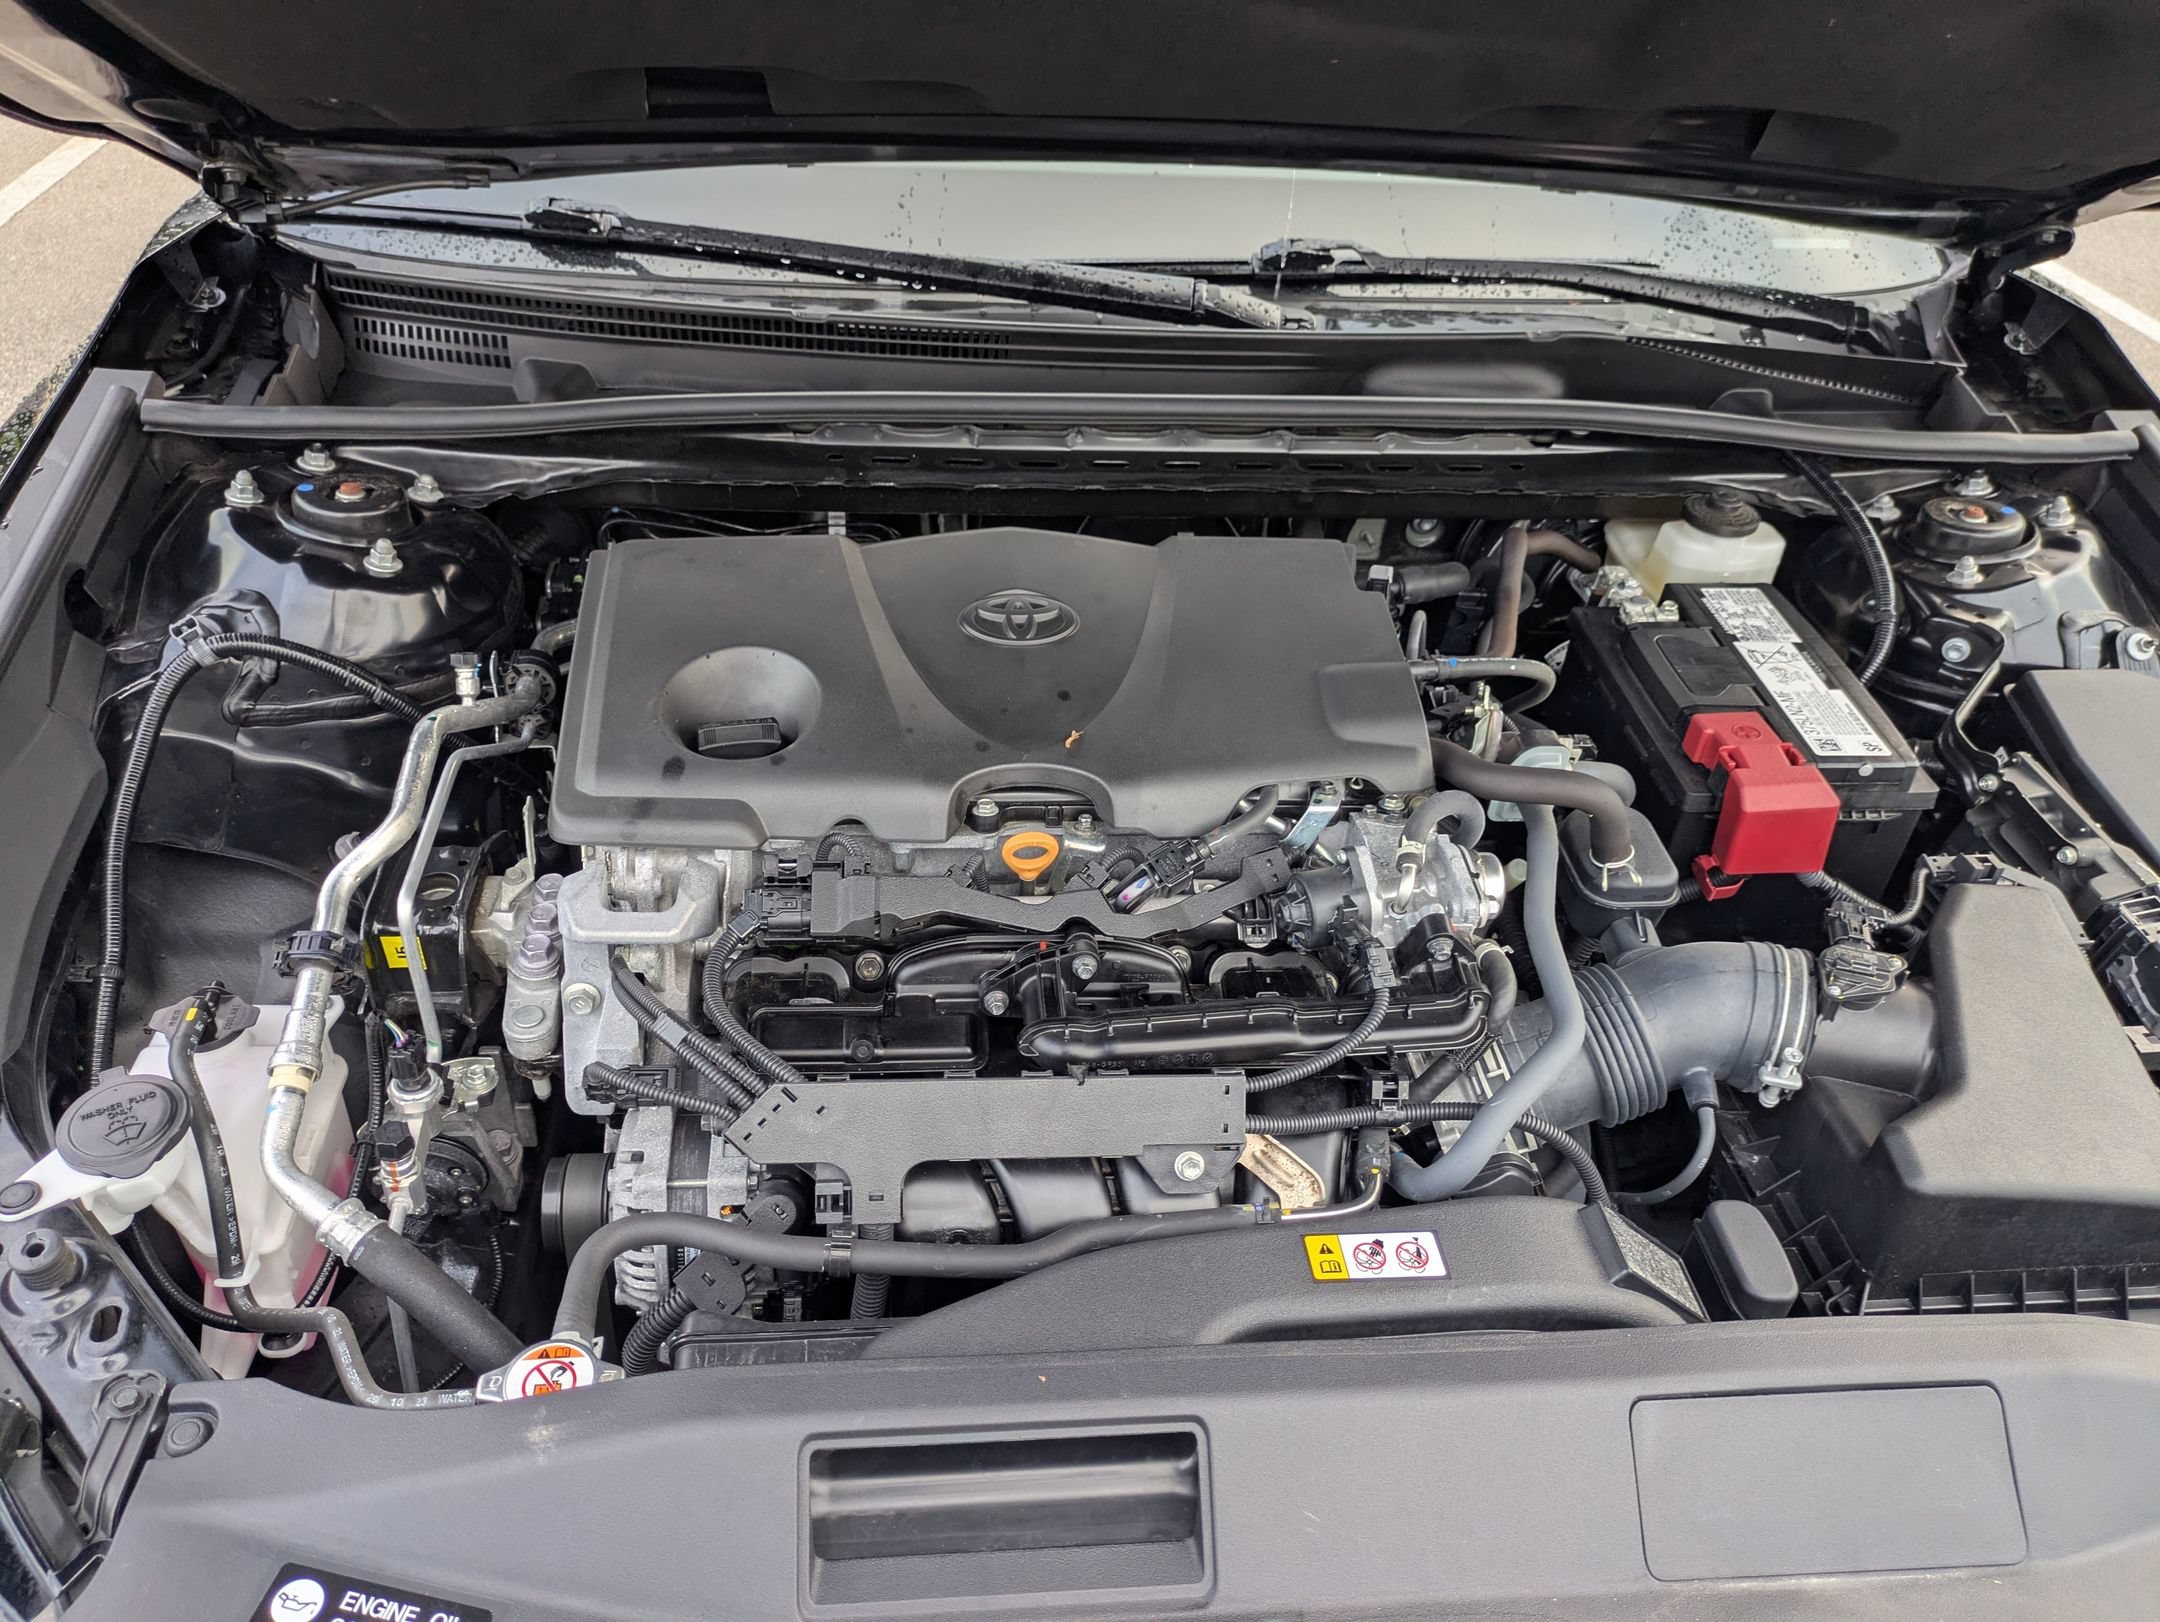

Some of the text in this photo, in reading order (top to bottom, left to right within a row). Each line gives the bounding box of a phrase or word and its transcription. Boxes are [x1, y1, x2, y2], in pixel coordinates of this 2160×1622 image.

[80, 1091, 157, 1121] WASHER FLUID
[107, 1105, 134, 1119] ONLY
[224, 1184, 235, 1216] WATER
[336, 1339, 353, 1368] WATER
[415, 1396, 428, 1407] 23
[438, 1393, 472, 1405] WATER
[338, 1590, 421, 1622] ENGINE
